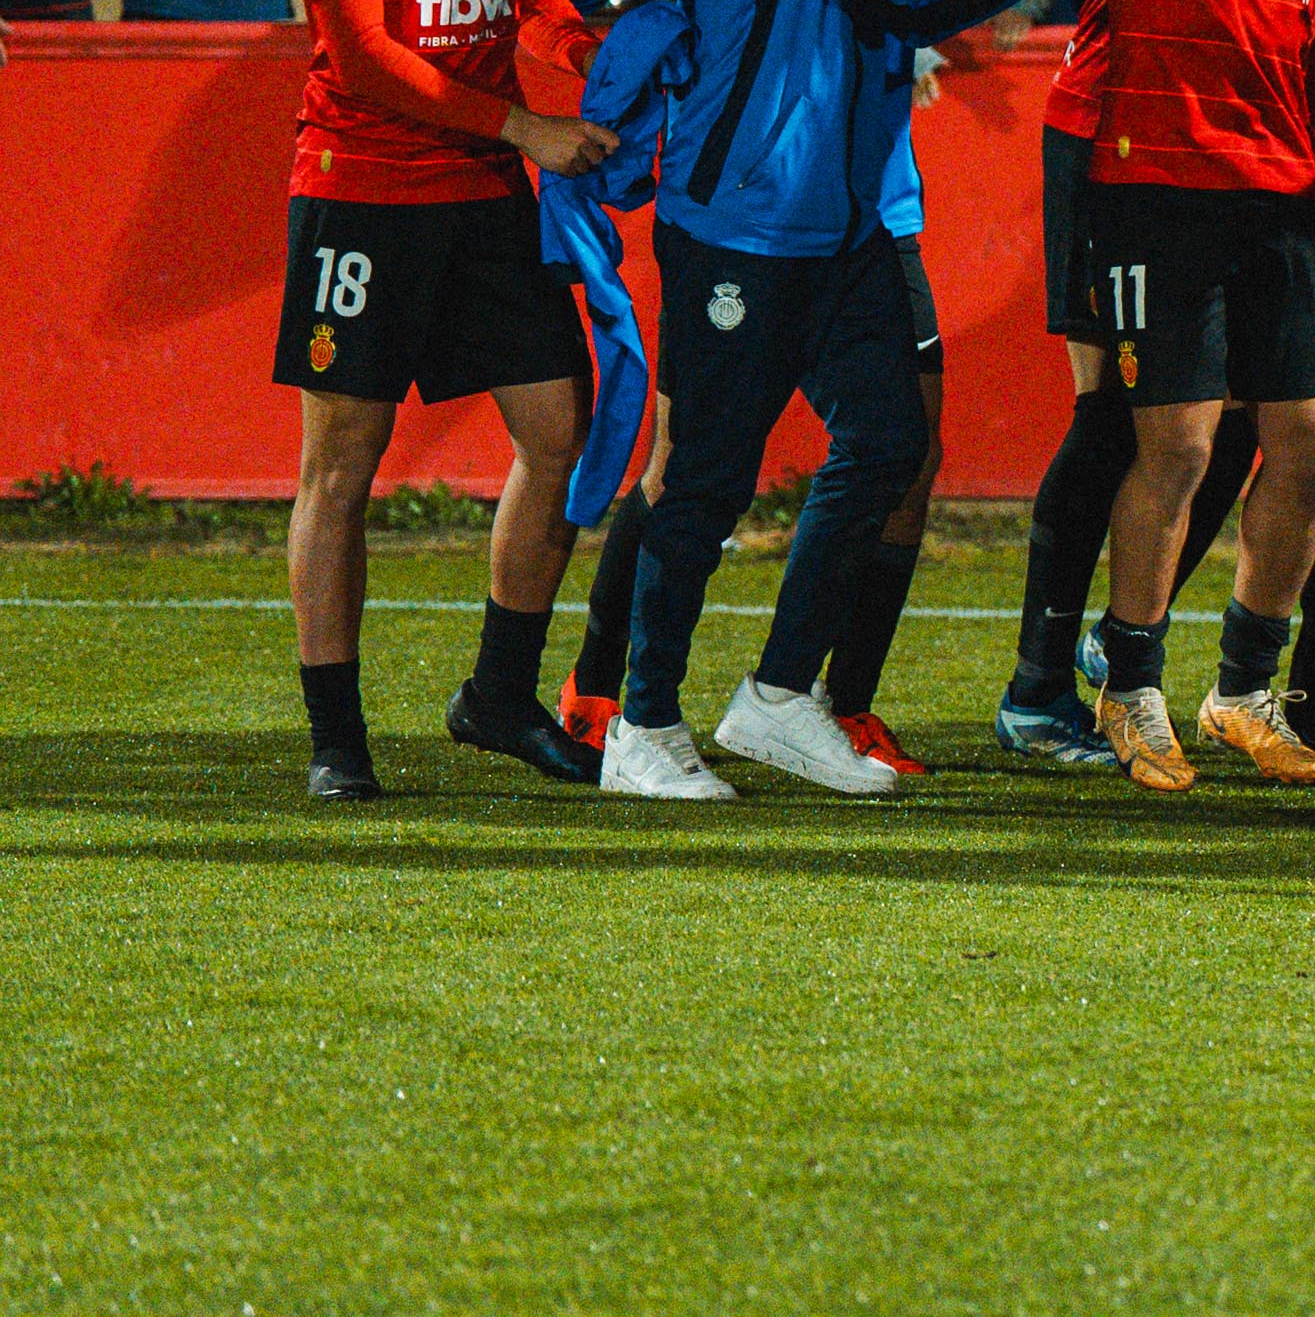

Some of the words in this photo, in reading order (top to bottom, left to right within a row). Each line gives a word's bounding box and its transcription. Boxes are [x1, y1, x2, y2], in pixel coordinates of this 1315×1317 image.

[419, 35, 459, 48] FIBRA
[315, 246, 372, 318] 18
[1109, 264, 1147, 330] 11
